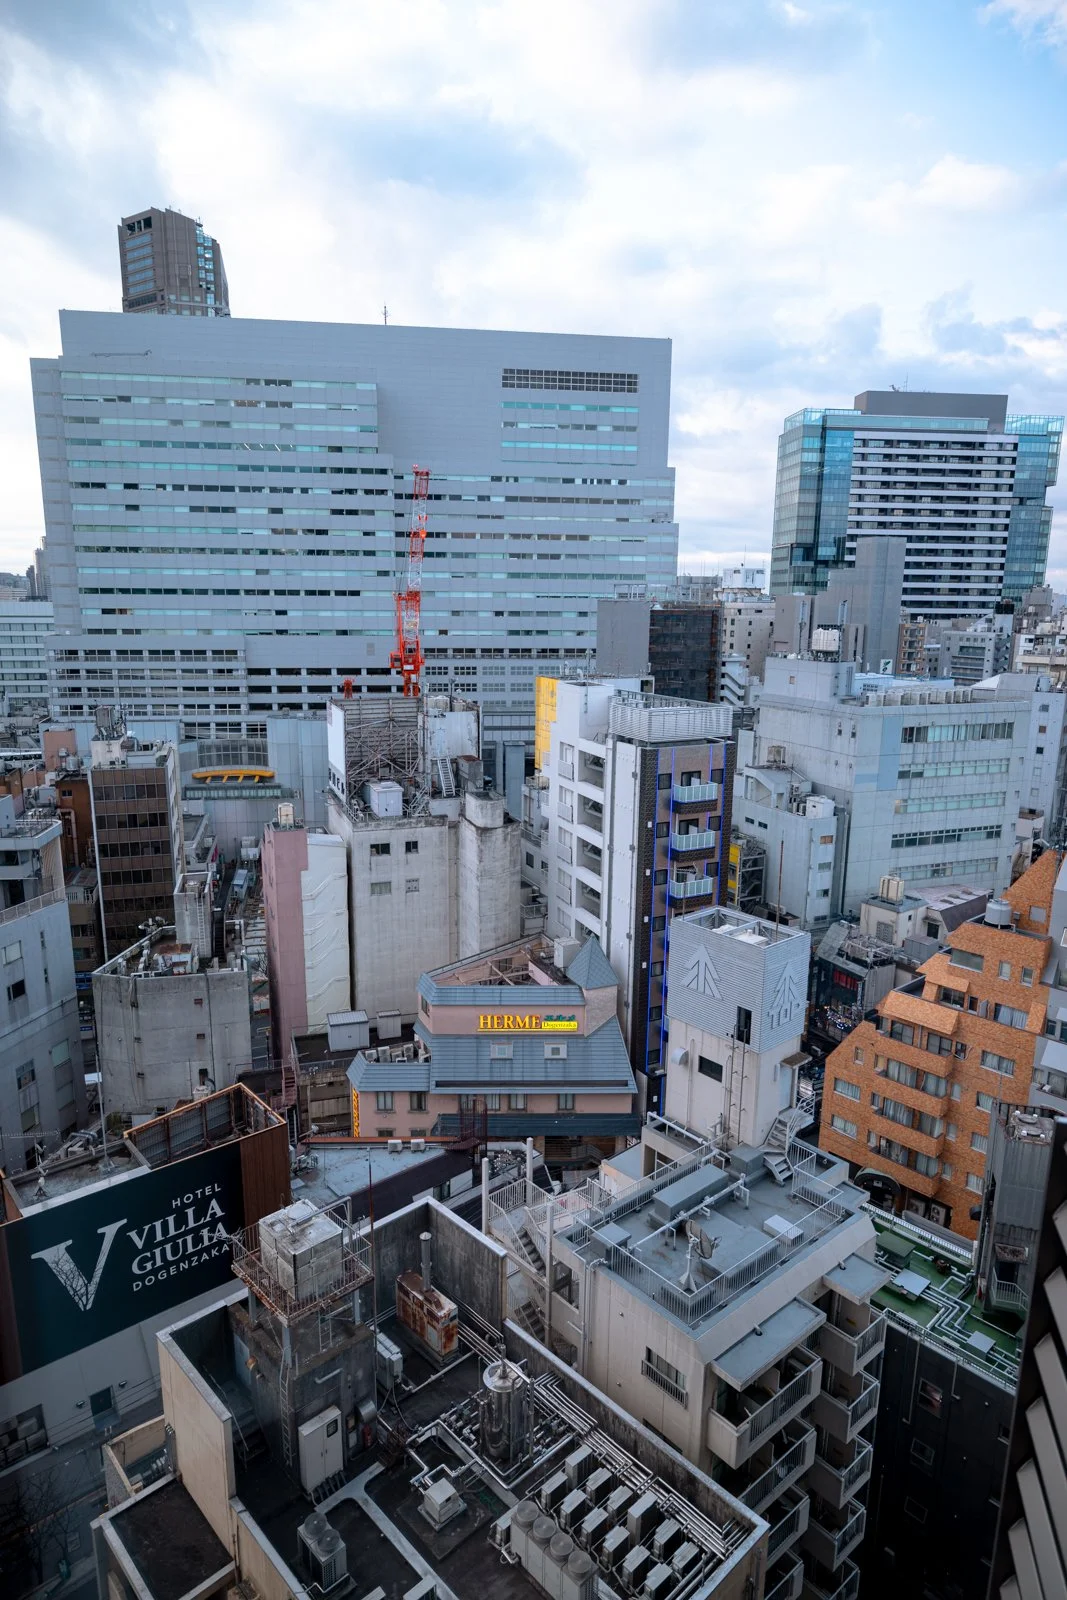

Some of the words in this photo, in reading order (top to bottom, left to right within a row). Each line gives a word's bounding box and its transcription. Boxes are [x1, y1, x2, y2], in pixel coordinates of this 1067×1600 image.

[479, 1015, 541, 1029] HERME
[543, 1021, 577, 1029] Dogenzaka
[172, 1183, 221, 1209] HOTEL
[126, 1198, 226, 1250] VILLA
[131, 1222, 229, 1275] GIULIA
[30, 1218, 128, 1311] V
[132, 1243, 230, 1292] DOGENZAKA
